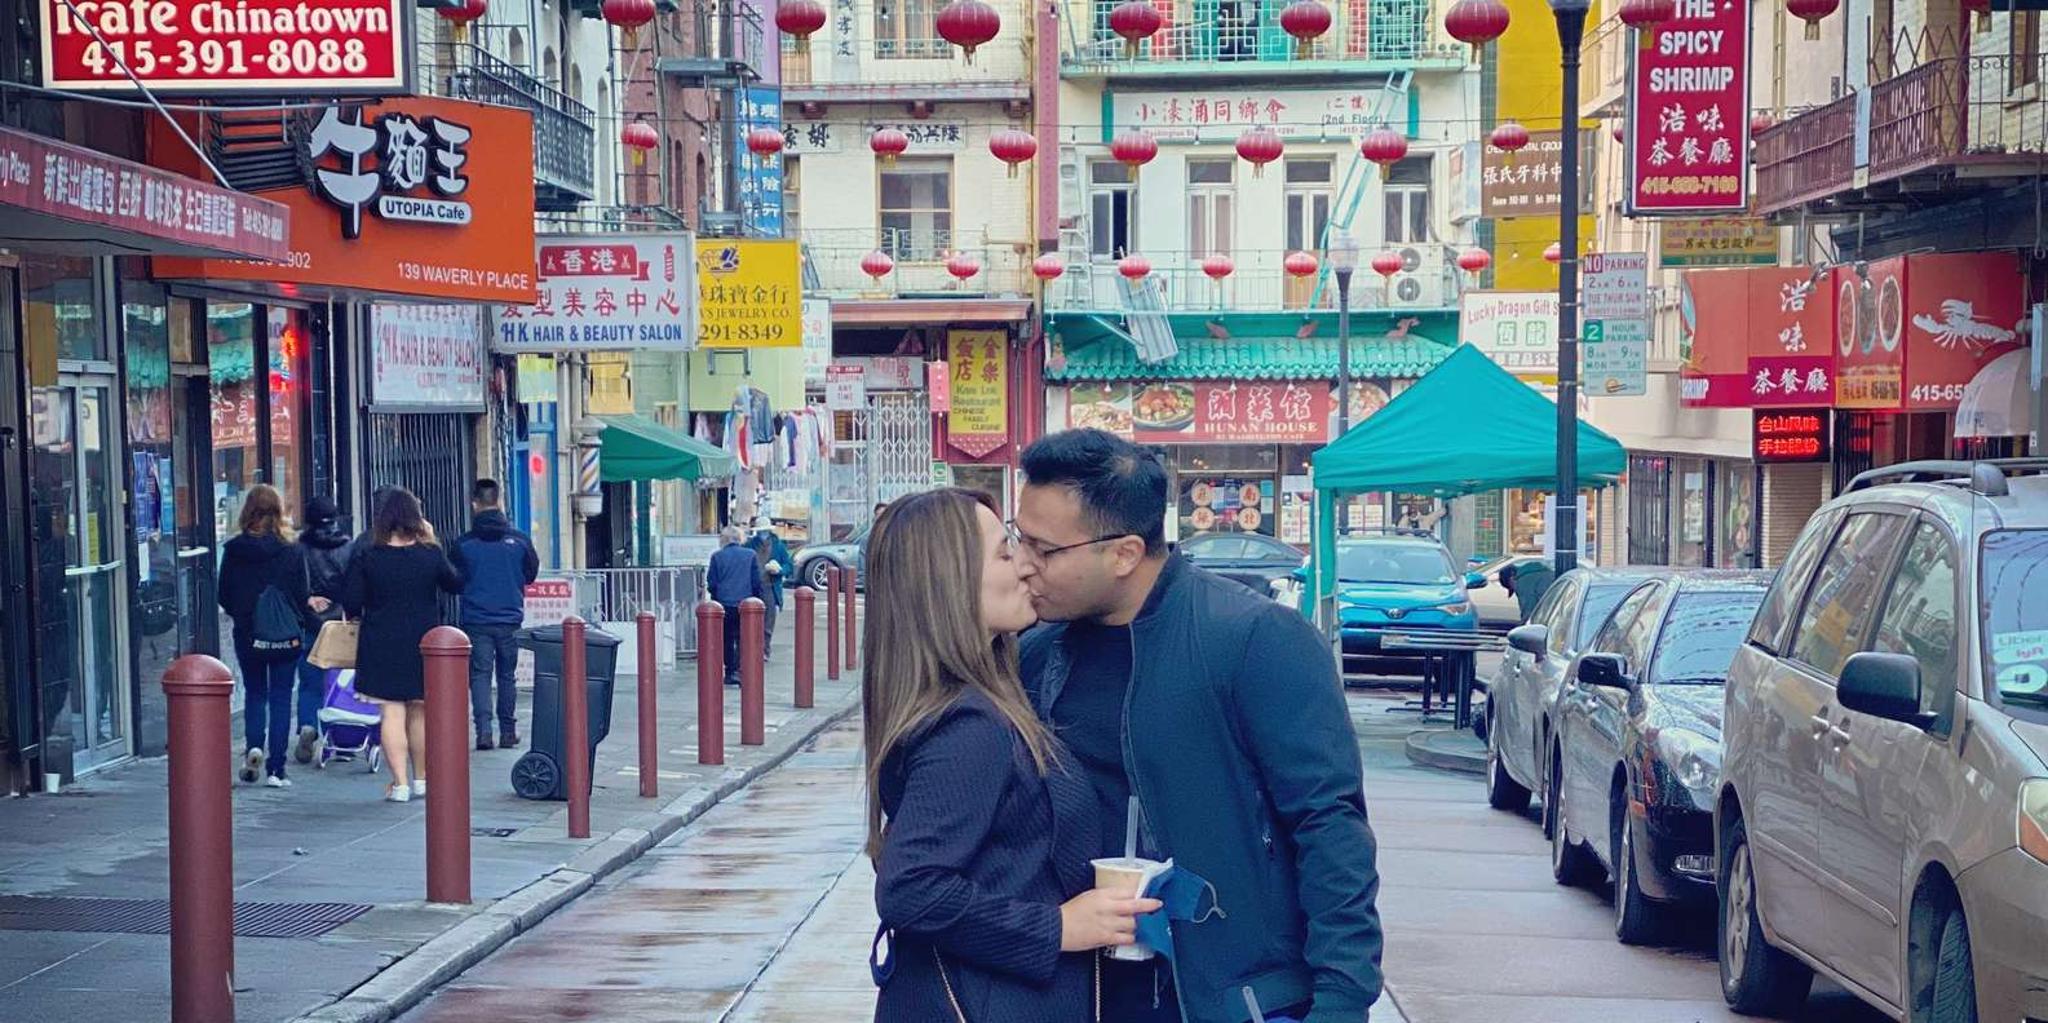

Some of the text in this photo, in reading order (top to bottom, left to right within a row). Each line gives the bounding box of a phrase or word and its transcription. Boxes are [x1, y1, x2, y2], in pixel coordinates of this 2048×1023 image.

[191, 3, 388, 33] Chinatown
[1674, 0, 1715, 18] THE
[1660, 31, 1724, 54] SPICY
[81, 39, 368, 74] 415-391-8088
[1650, 68, 1734, 92] SHRIMP
[1484, 161, 1581, 186] 張氏牙科中
[385, 200, 465, 219] UTOPIA Cafe
[561, 248, 618, 272] 香港
[1585, 255, 1645, 272] NO PARKING
[398, 262, 528, 289] 139 WAVERLY PLACE
[716, 307, 767, 320] JEWELRY
[1468, 303, 1496, 323] Lucky
[1498, 301, 1531, 317] Dragon
[533, 325, 564, 342] HAIR
[569, 325, 579, 342] &
[583, 325, 635, 341] BEAUTY
[639, 324, 682, 341] SALON
[700, 323, 783, 341] 291-8349
[1587, 324, 1600, 340] 2
[1611, 324, 1637, 333] HOUR
[1911, 384, 1965, 401] 415-65
[1204, 421, 1320, 433] HUNAN HOUSE
